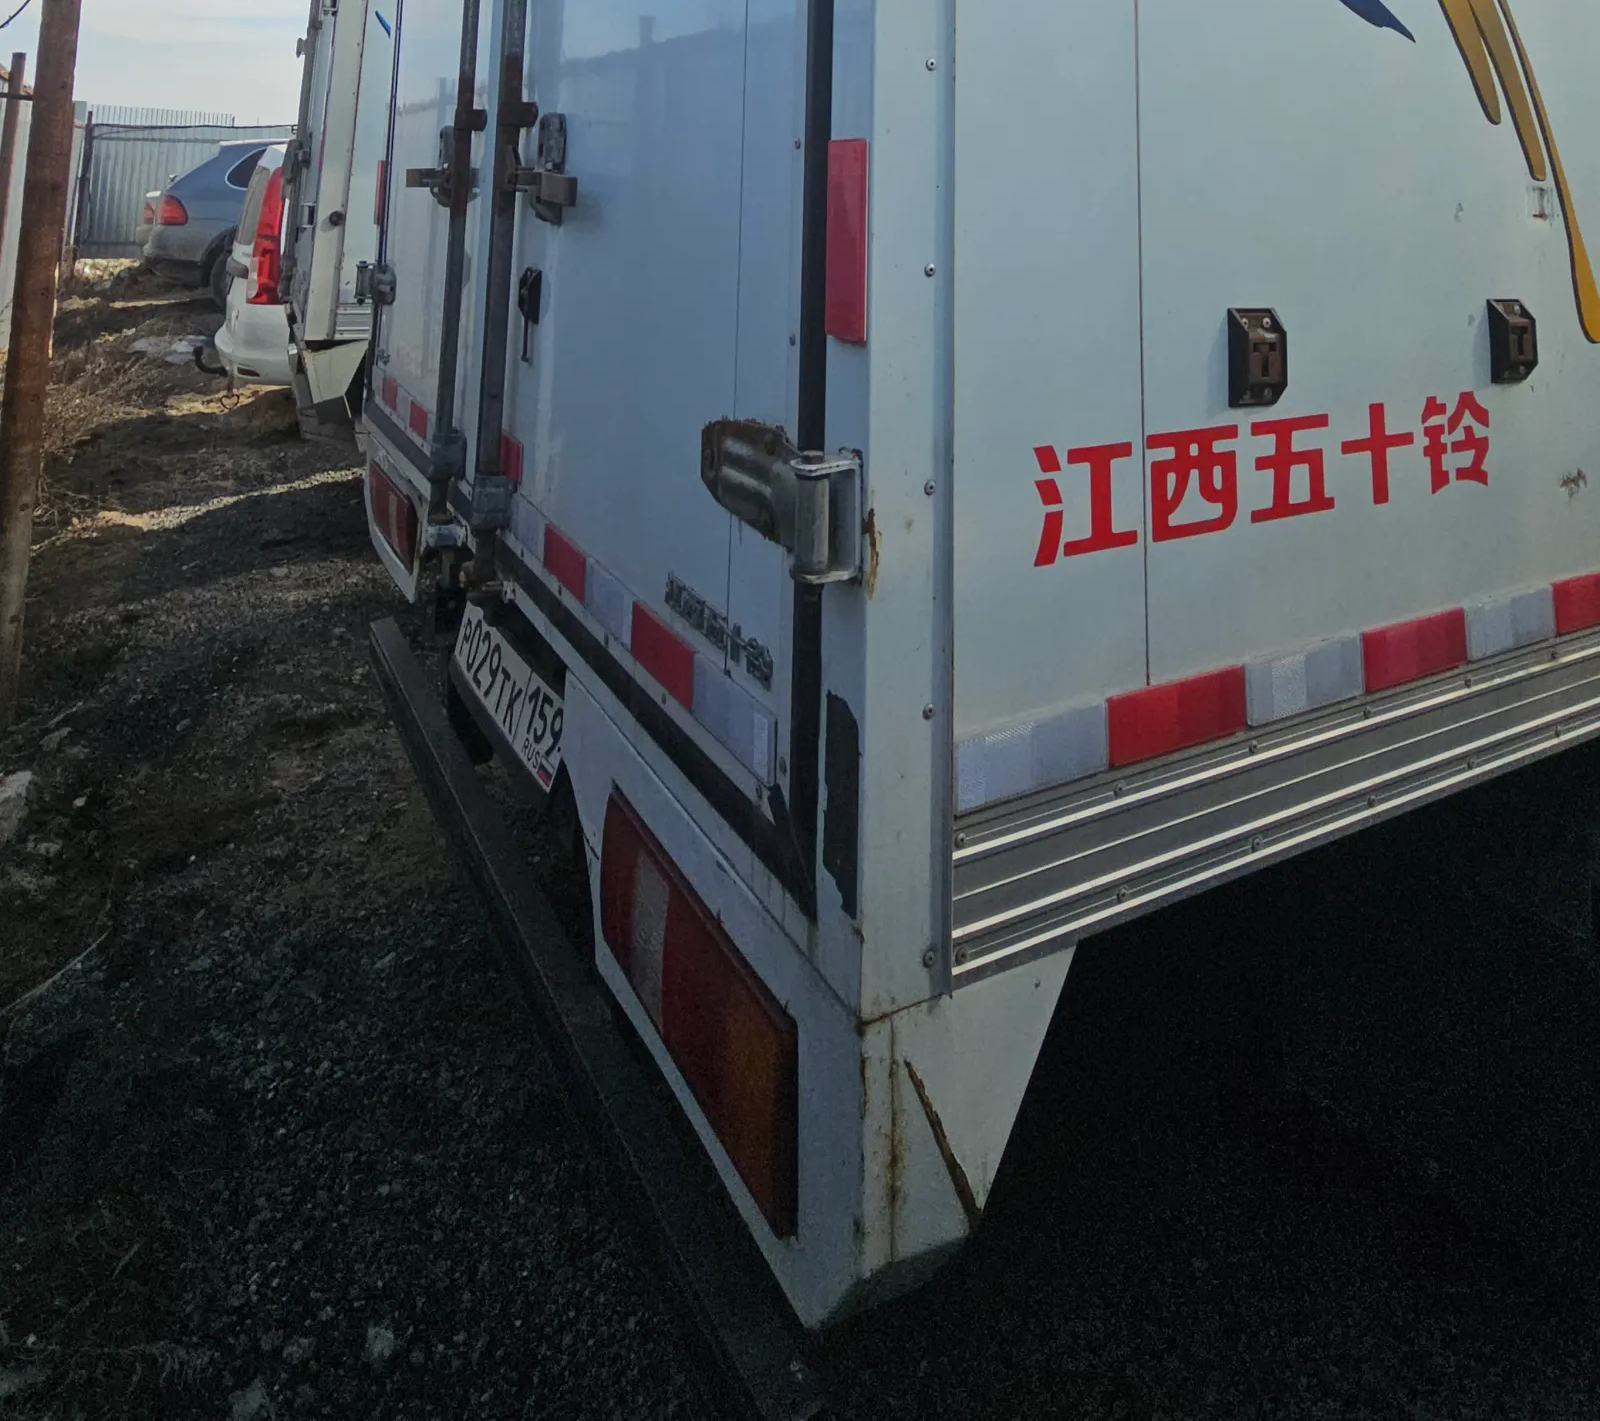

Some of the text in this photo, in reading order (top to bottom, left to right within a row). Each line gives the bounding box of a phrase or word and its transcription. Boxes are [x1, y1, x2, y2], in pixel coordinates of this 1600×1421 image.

[1033, 391, 1490, 567] 江西五十铃
[521, 737, 541, 770] RUS
